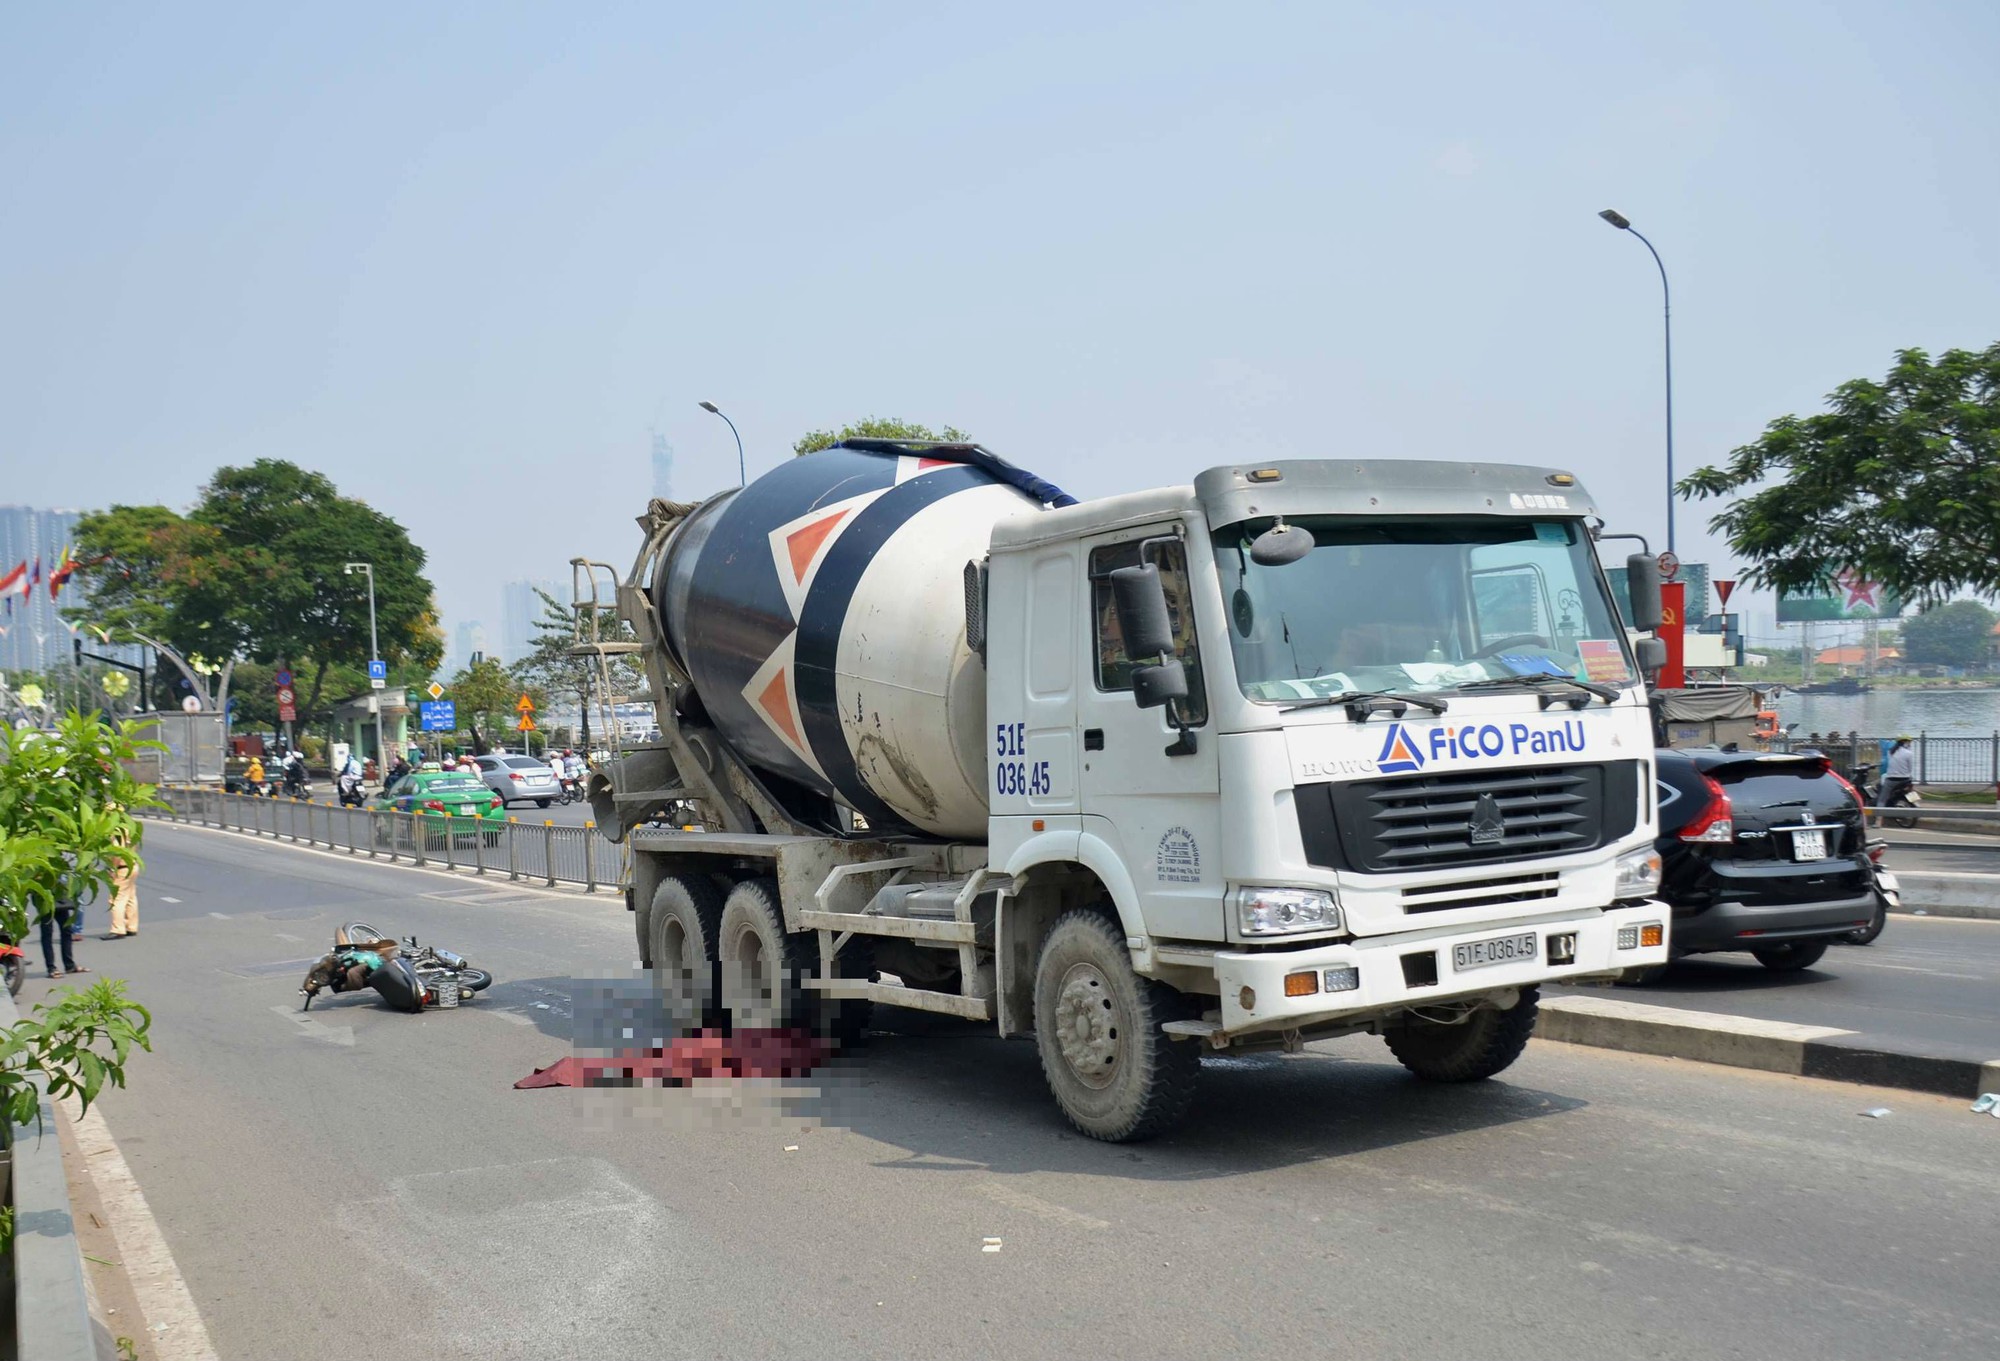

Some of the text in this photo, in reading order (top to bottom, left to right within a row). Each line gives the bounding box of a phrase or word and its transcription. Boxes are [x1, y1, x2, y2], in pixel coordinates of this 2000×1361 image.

[997, 722, 1025, 756] 51E
[1509, 720, 1586, 755] PanU
[997, 761, 1050, 796] 036.45
[1303, 759, 1377, 777] HOWO
[1457, 936, 1534, 966] 51E-036.45
